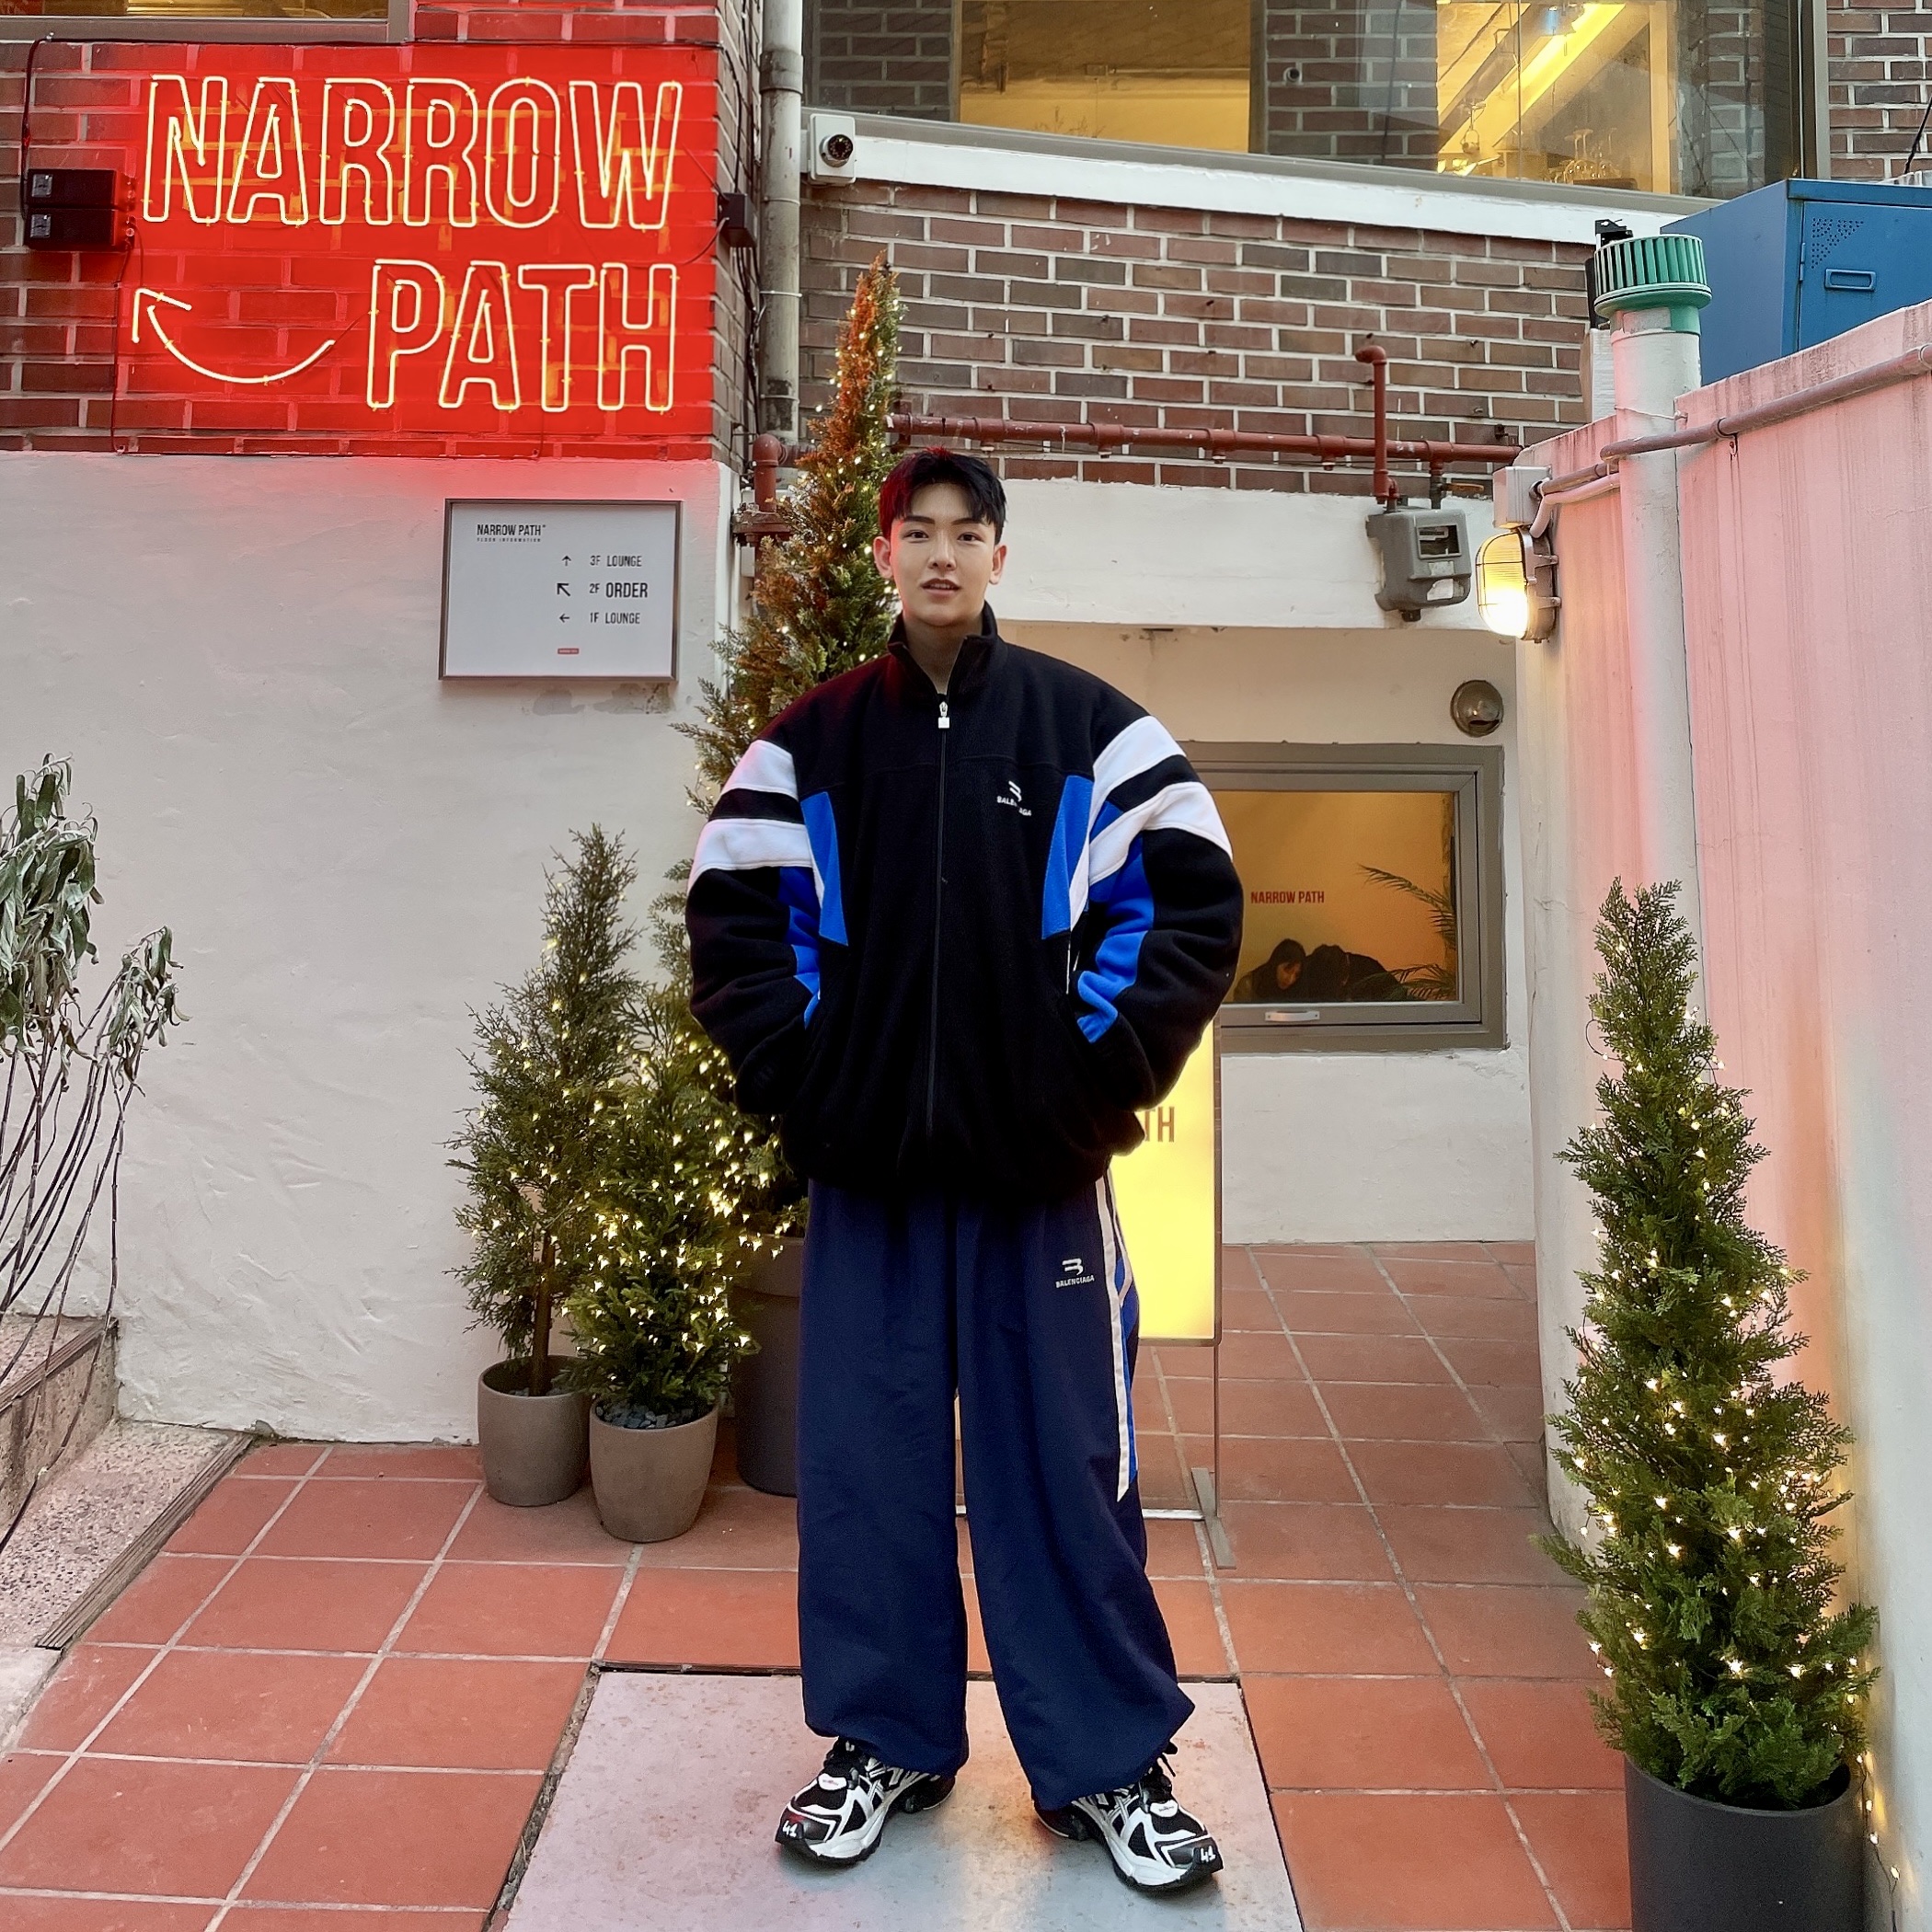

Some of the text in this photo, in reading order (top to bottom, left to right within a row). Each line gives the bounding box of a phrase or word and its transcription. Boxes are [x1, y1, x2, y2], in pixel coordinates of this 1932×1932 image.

[142, 74, 683, 230] NARROW
[366, 259, 677, 412] PATH
[477, 523, 516, 535] NARROW
[590, 555, 642, 567] 3F LOUNGE
[589, 581, 648, 598] 2F ORDER
[590, 612, 640, 625] 1F LOUNGE
[1250, 891, 1325, 903] NARROW PATH
[1055, 1274, 1095, 1289] BALENCIAGA
[782, 1820, 799, 1838] 41
[1200, 1845, 1216, 1863] 41
